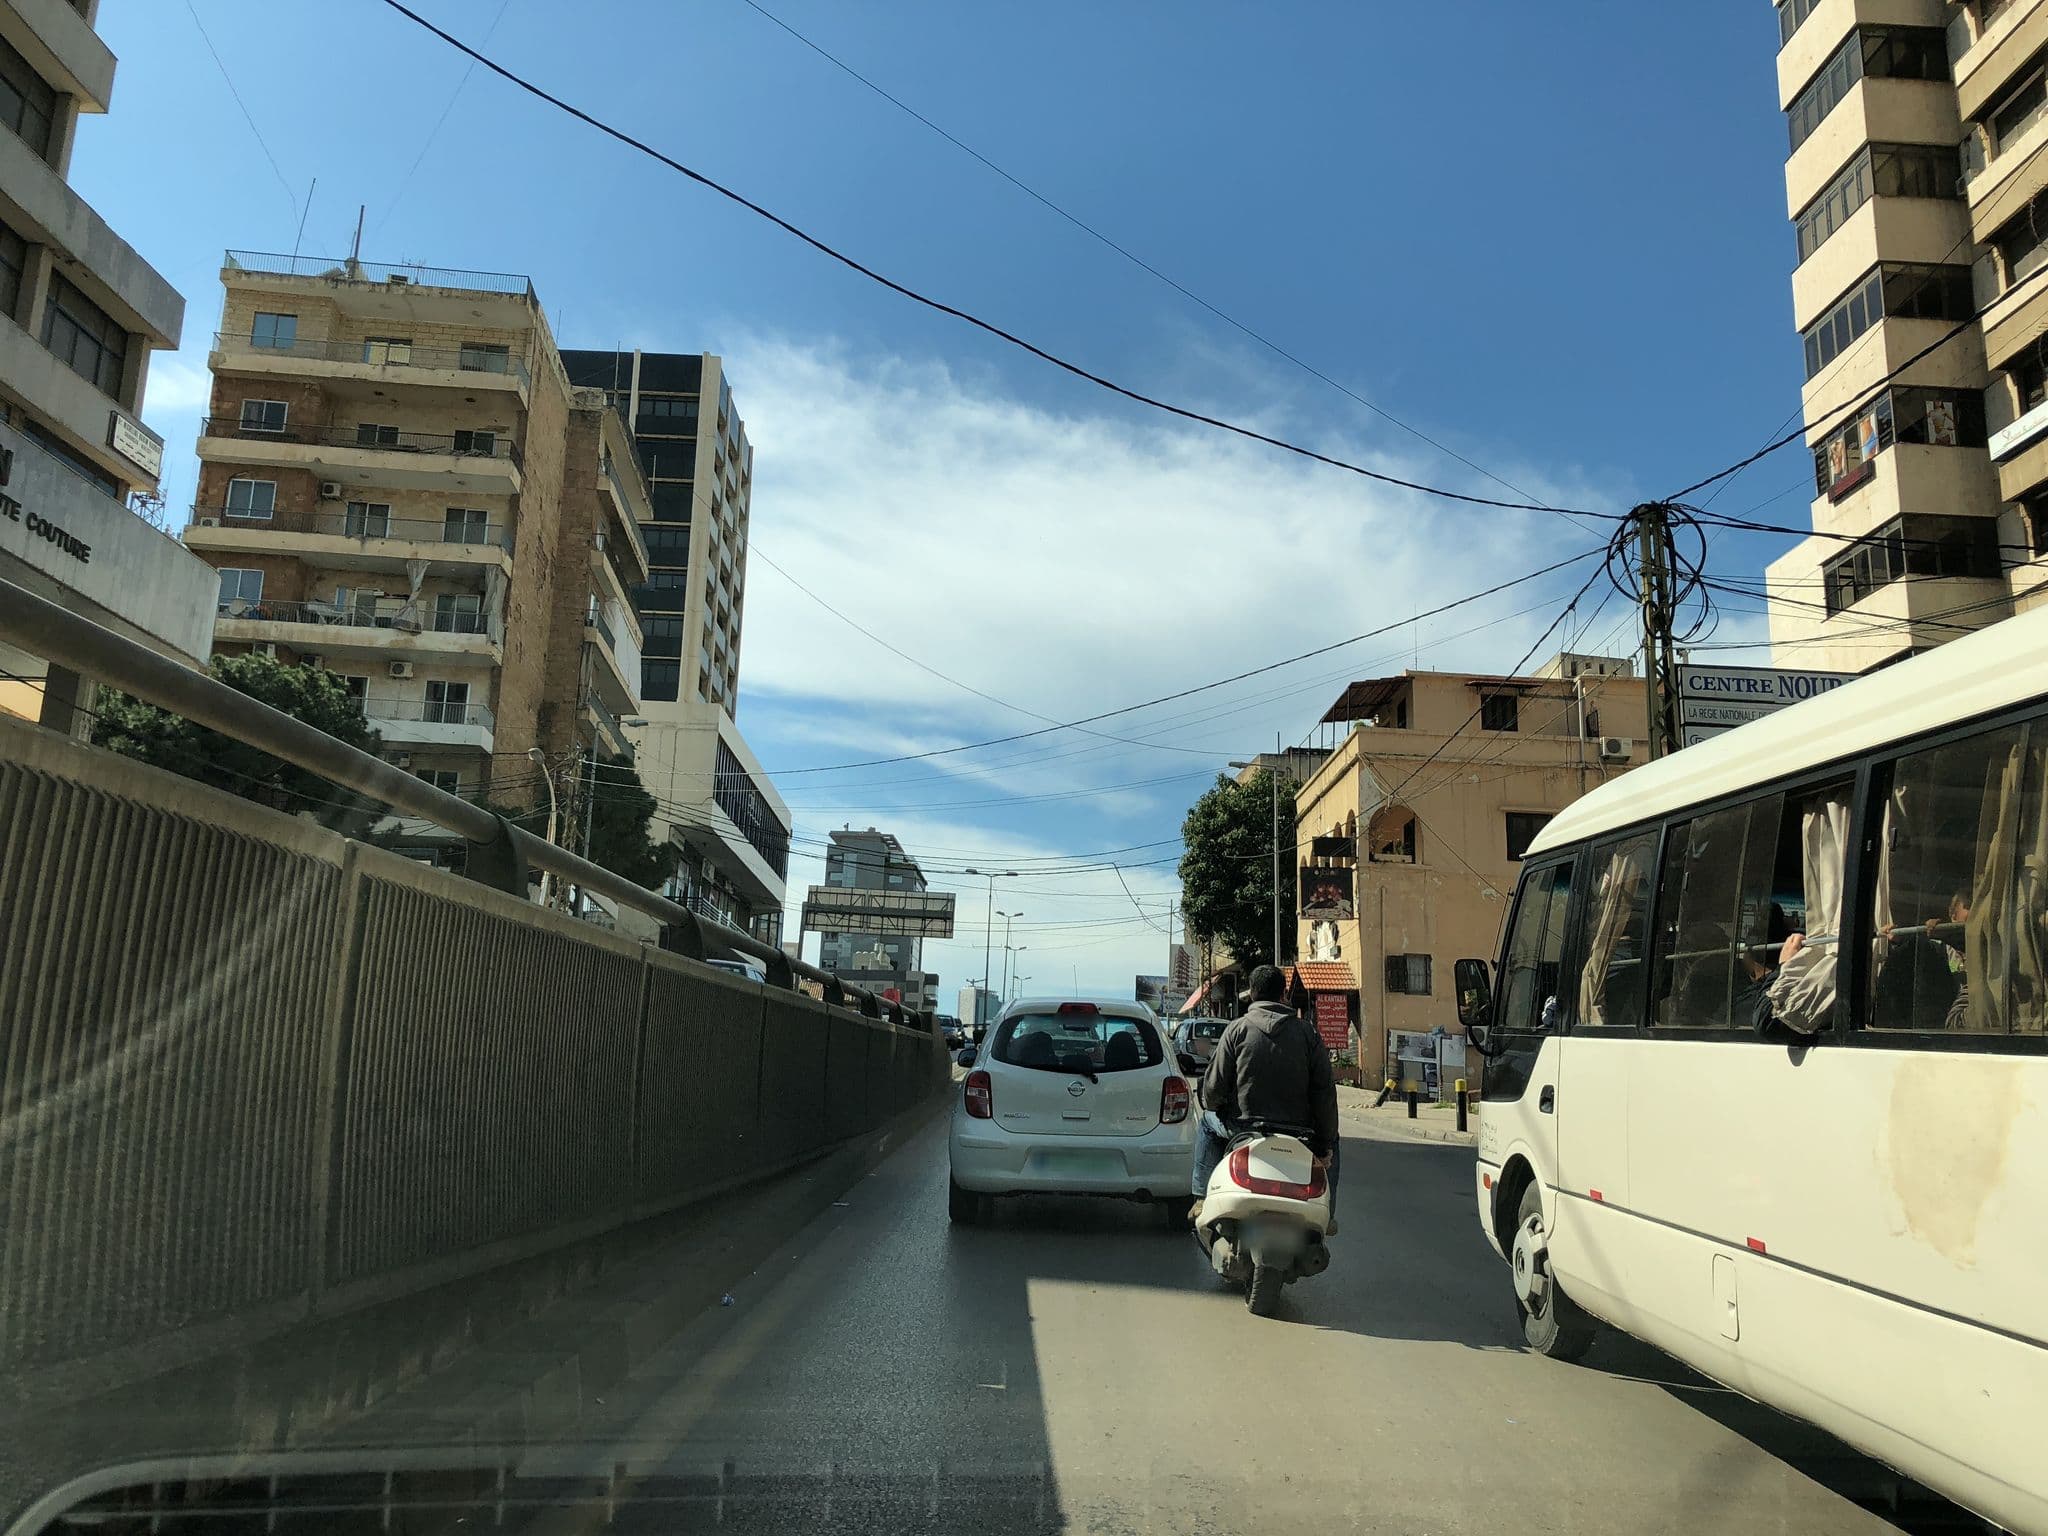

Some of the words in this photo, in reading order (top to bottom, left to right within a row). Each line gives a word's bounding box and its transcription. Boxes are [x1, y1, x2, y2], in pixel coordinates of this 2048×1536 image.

[0, 492, 22, 522] TE
[26, 512, 92, 564] COUTURE
[1689, 675, 1774, 694] CENTRE
[1688, 707, 1697, 718] LA
[1720, 709, 1757, 721] NATIONALE
